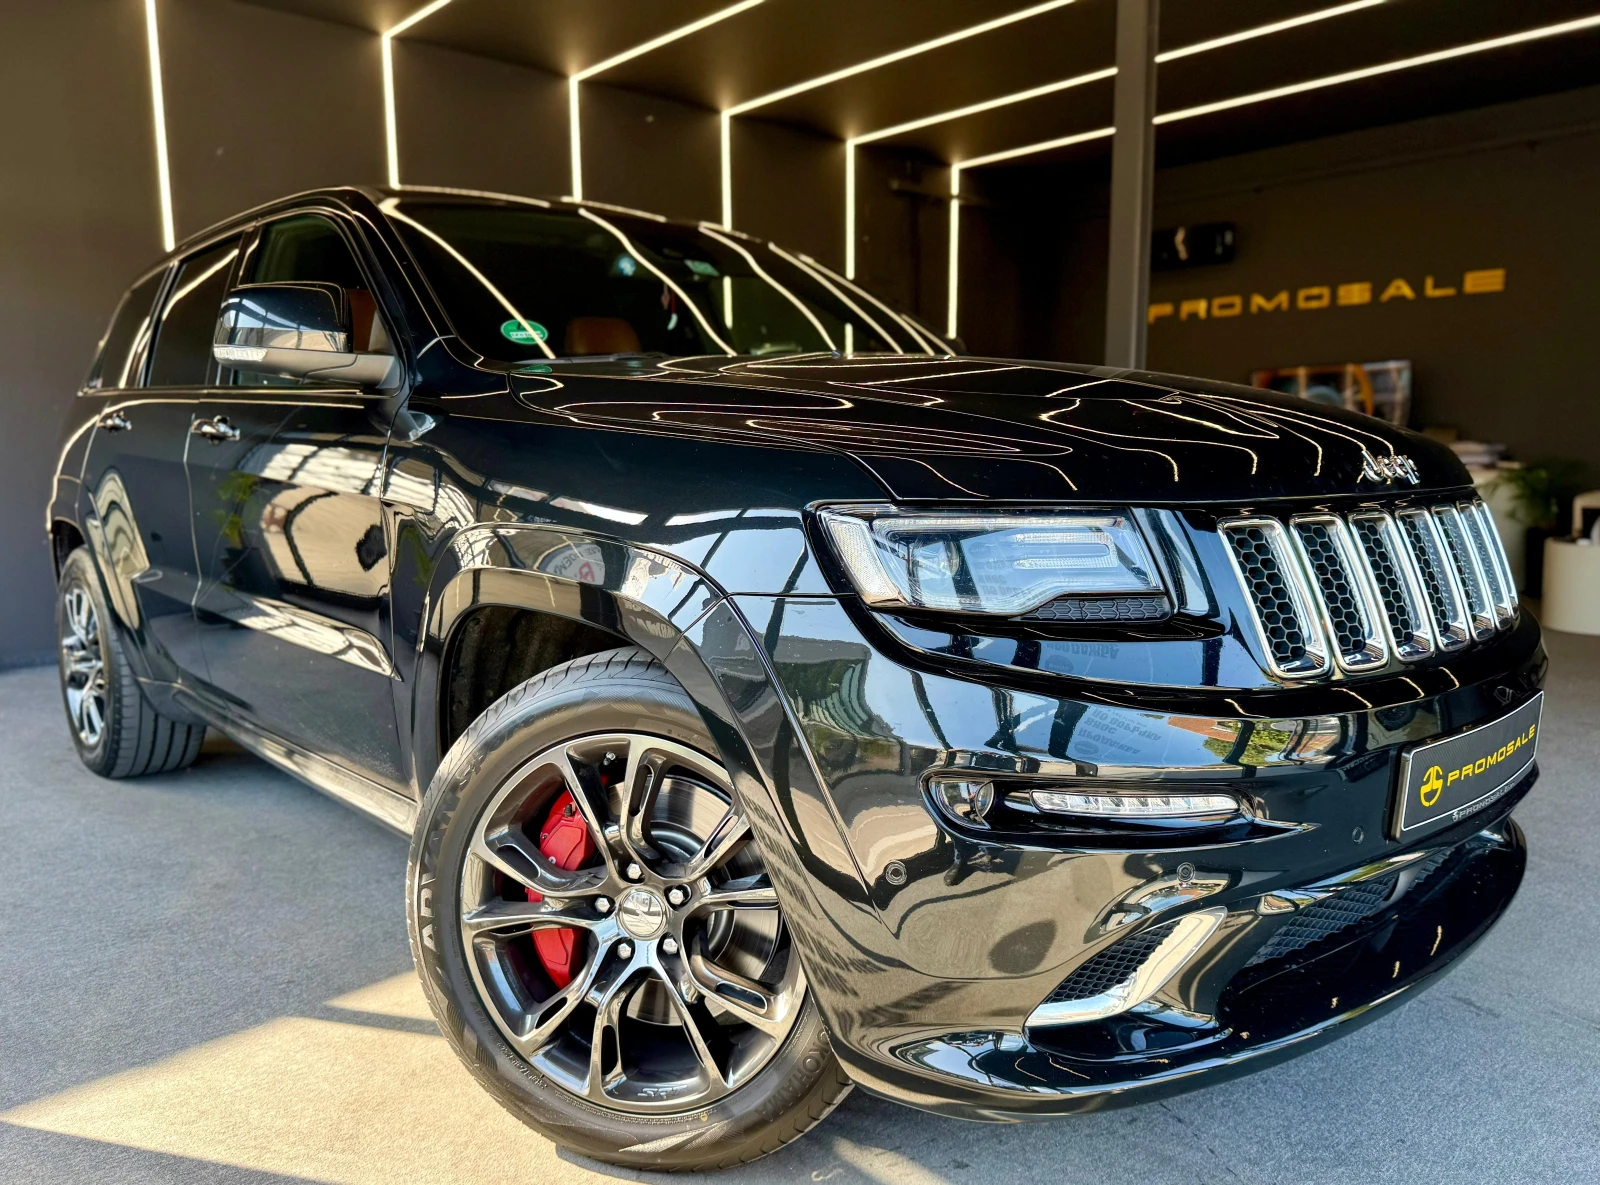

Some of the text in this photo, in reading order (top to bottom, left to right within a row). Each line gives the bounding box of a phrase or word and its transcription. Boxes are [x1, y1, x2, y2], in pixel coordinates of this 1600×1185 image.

[1146, 268, 1506, 324] PROMOSALE
[1447, 724, 1536, 787] PROMOSALE
[636, 1084, 688, 1099] SRT
[760, 1028, 832, 1122] OKOHAMA
